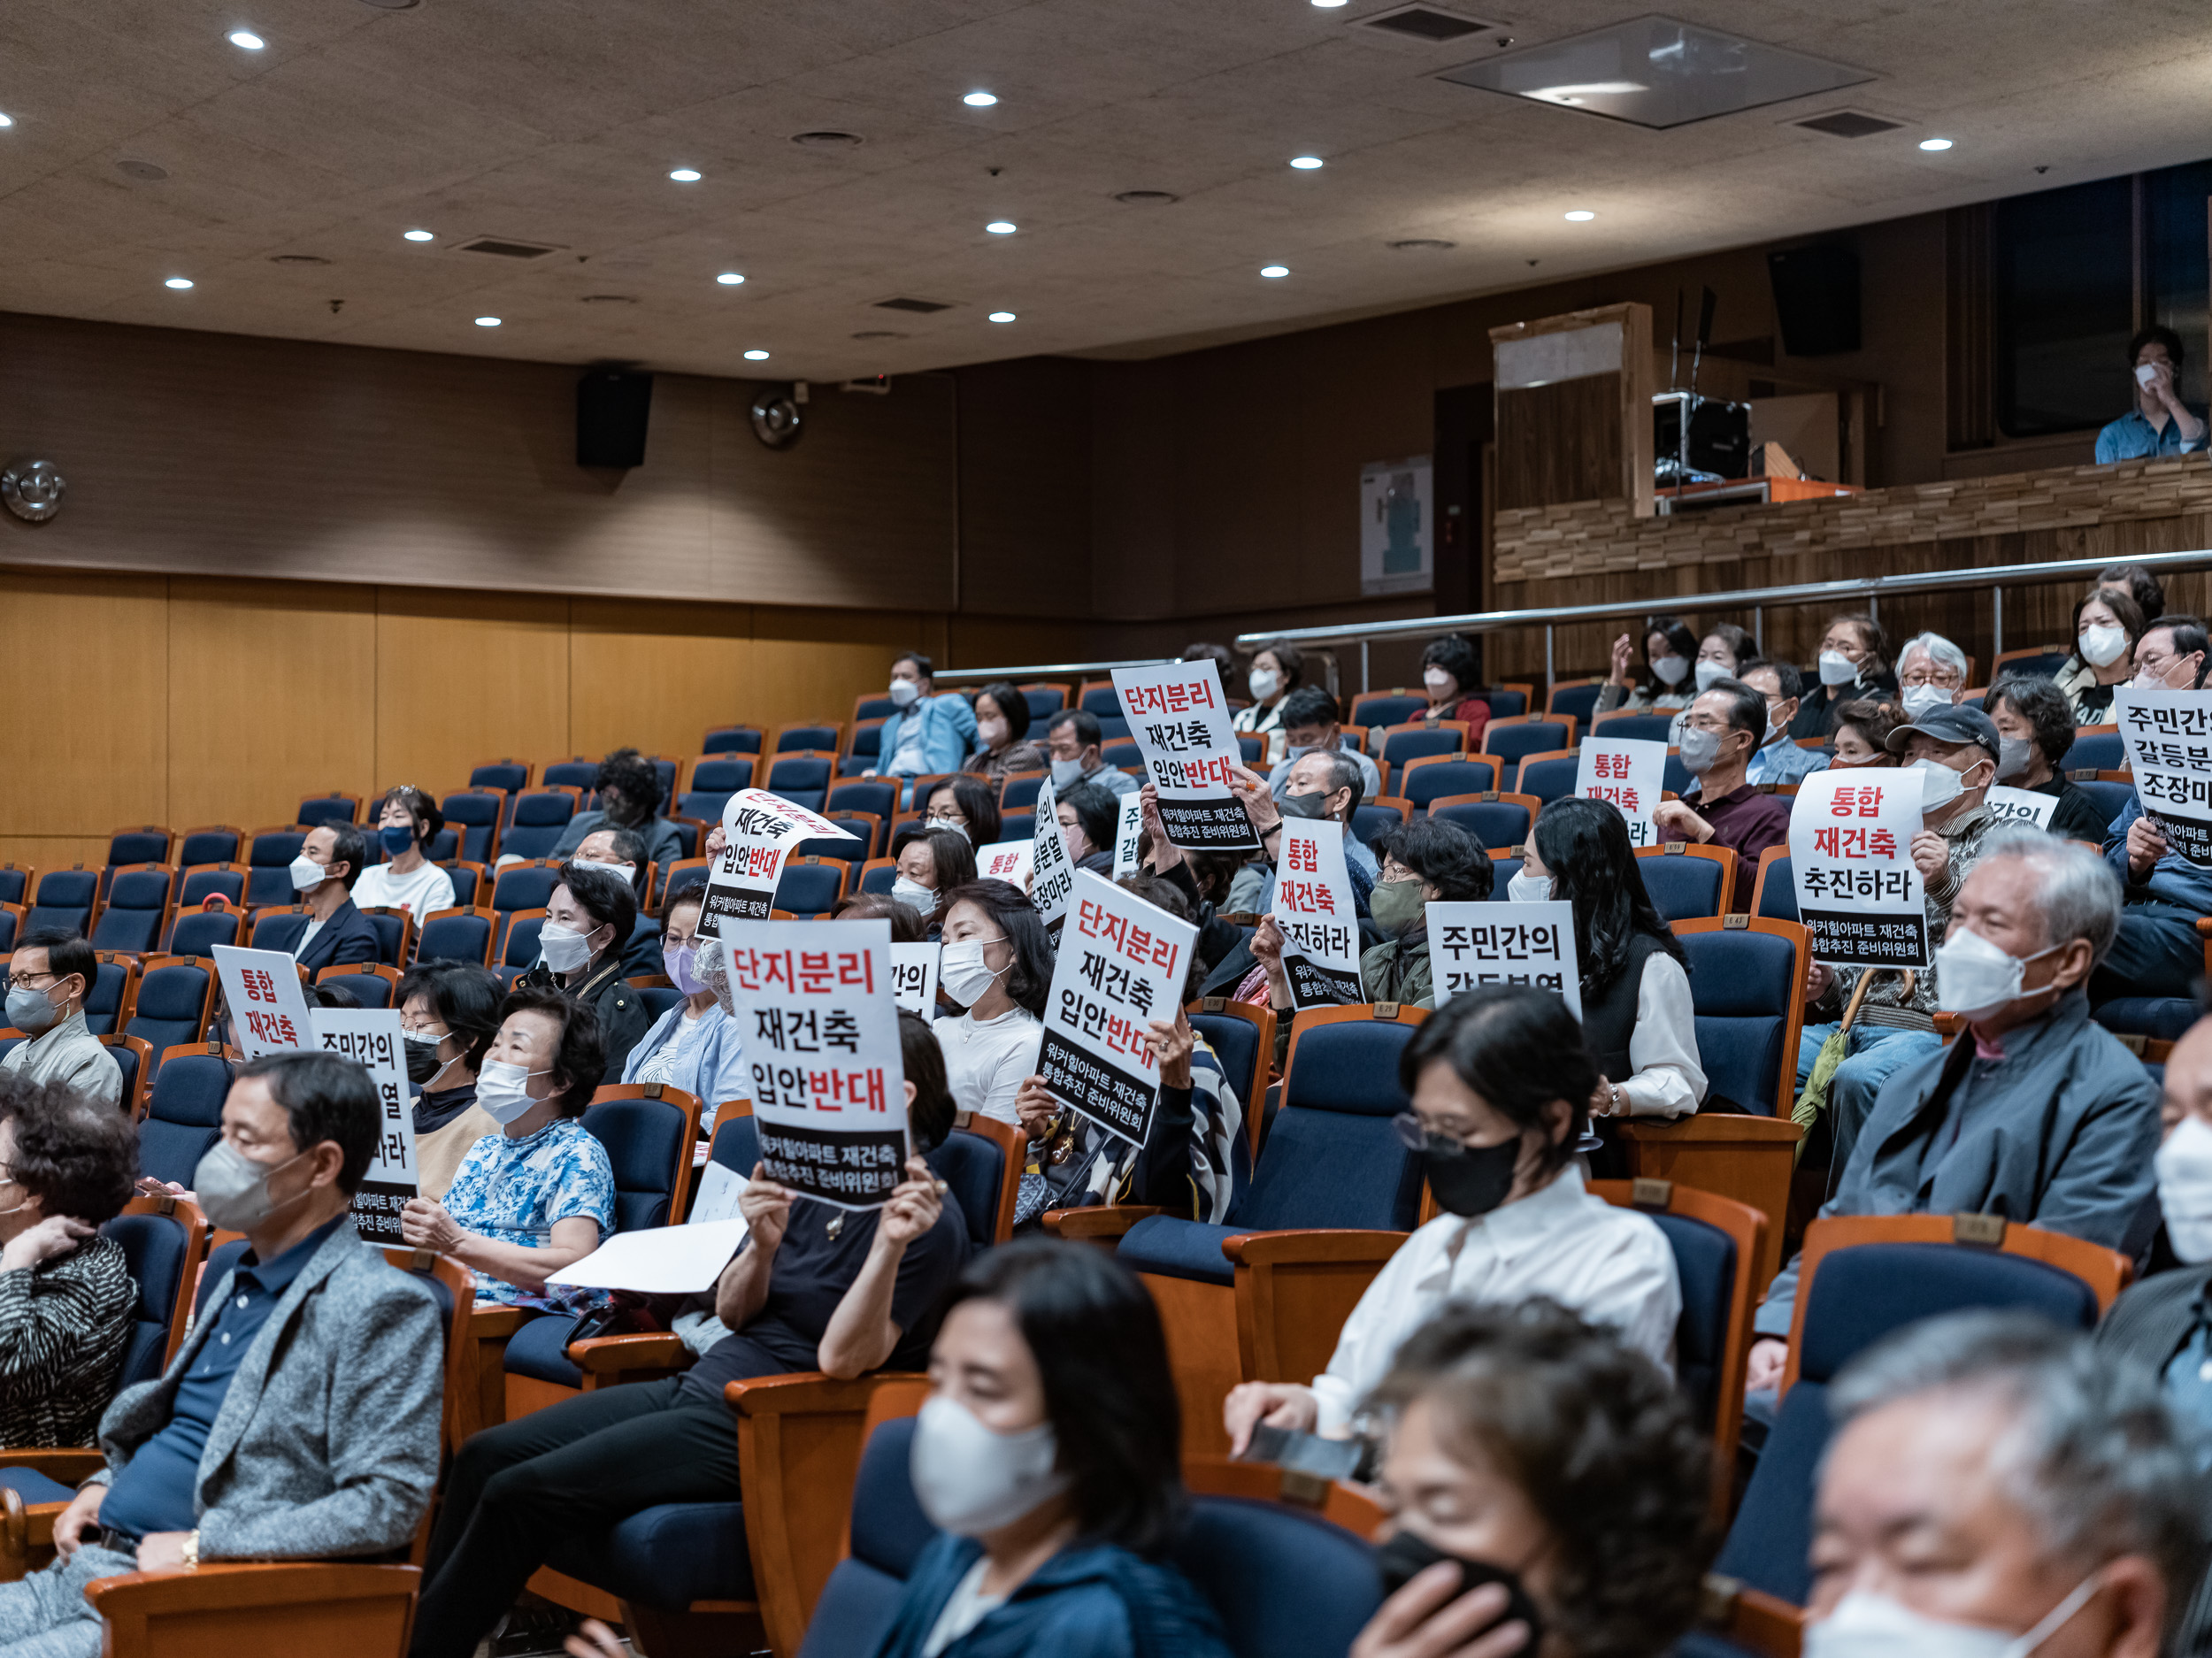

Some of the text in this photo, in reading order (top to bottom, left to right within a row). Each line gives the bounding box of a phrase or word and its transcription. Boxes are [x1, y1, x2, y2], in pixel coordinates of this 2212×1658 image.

[1125, 679, 1215, 715] 단지분리
[1145, 720, 1212, 752] 재건축
[2127, 705, 2212, 736] 주민간
[1153, 755, 1233, 788] 입안반대
[1594, 754, 1632, 779] 통합
[746, 793, 838, 834] 단지분리
[1162, 806, 1245, 823] 워커힐아파트 재건축
[1830, 787, 1884, 817] 통합
[734, 807, 795, 840] 재건축
[1167, 823, 1250, 839] 통합추진 준비위원회
[1287, 838, 1318, 873] 통합
[1814, 827, 1897, 859] 재건축
[723, 843, 781, 879] 입안반대
[989, 852, 1019, 875] 통합
[1280, 879, 1335, 916] 재건축
[1804, 867, 1912, 902] 추진하라
[709, 894, 768, 917] 워커힐아파트 재건축
[1078, 898, 1179, 979] 단지분리
[1442, 924, 1561, 961] 주민간의
[1856, 940, 1919, 958] 준비위원회
[1879, 924, 1917, 940] 재건축
[241, 968, 278, 1003] 통합
[733, 948, 874, 994] 단지분리
[1079, 950, 1154, 1017] 재건축
[244, 1009, 299, 1048] 재건축
[754, 1007, 860, 1054] 재건축
[752, 1063, 887, 1113] 입안반대
[1046, 1041, 1148, 1113] 워커힐아파트 재건축
[1042, 1060, 1144, 1132] 통합추진 준비위원회
[841, 1144, 897, 1168] 재건축
